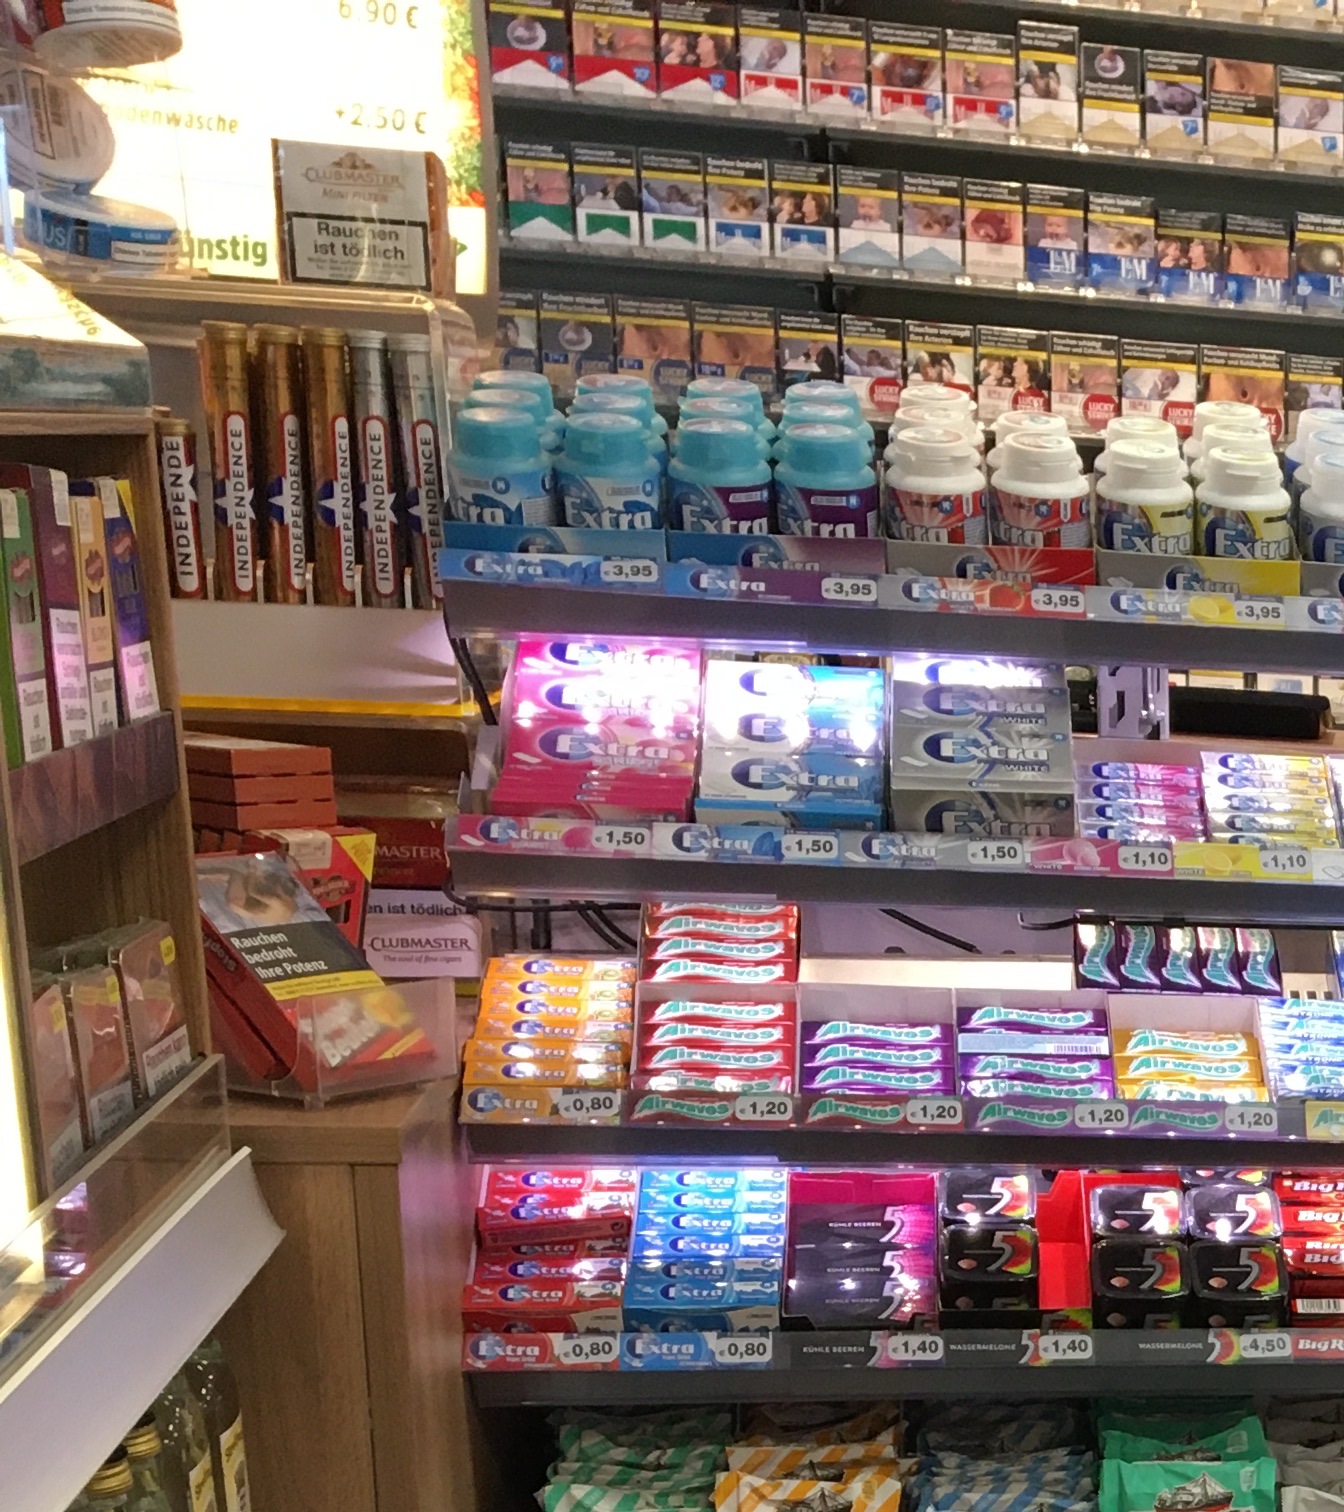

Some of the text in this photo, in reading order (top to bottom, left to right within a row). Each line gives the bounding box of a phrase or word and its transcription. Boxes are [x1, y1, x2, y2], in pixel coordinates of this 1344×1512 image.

[301, 167, 403, 184] CLUBMASTER
[317, 220, 399, 241] Rauchen
[313, 240, 404, 261] ist tödlich
[230, 428, 249, 579] INDEPENDENCE
[370, 432, 390, 580] INDEPENDENCE
[1215, 532, 1290, 560] Extra
[556, 733, 670, 758] Extra
[388, 902, 462, 916] ist tödlich
[231, 932, 287, 949] Rauchen
[368, 938, 471, 950] CLUBMASTER
[245, 948, 297, 964] bedroht
[256, 959, 328, 978] Ihre Potenz
[660, 1001, 779, 1021] Airwaves
[816, 1023, 939, 1042] Airwaves
[1130, 1031, 1247, 1055] Airwaves
[636, 1097, 730, 1117] Airwaves
[833, 1344, 864, 1354] BEEREN
[1138, 1343, 1203, 1351] WASSERMELONE
